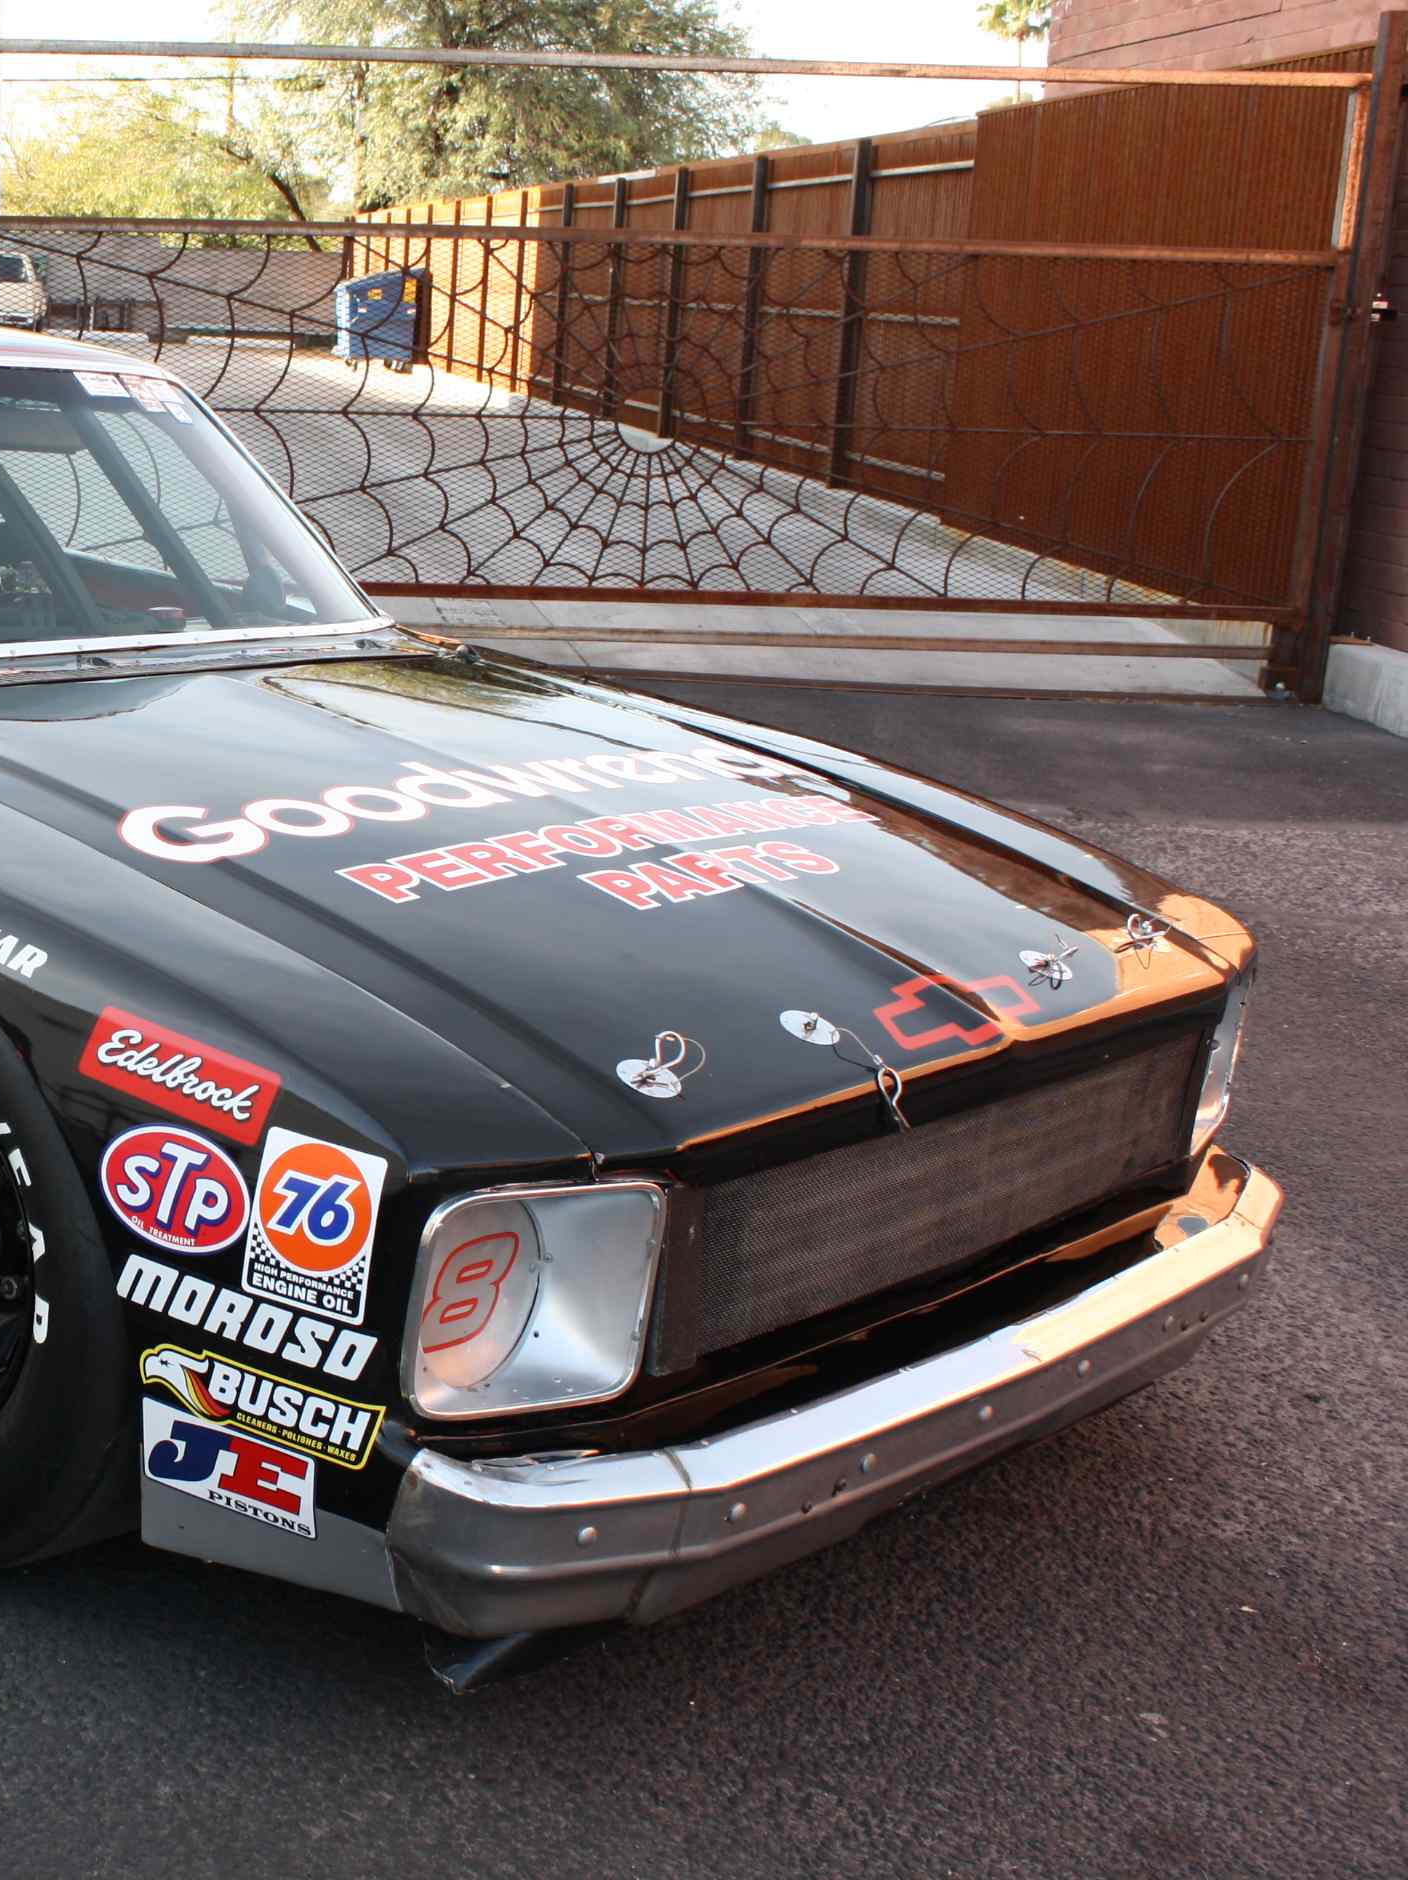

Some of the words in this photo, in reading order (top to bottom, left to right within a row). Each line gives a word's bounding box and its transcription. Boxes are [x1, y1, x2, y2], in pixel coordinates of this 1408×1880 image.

[335, 794, 881, 903] PERFORMANCE
[578, 840, 841, 910] PARTS
[96, 1028, 261, 1122] Edelbrock
[115, 1140, 232, 1238] STP
[130, 1214, 146, 1230] OIL
[148, 1226, 197, 1247] TREATMENT
[267, 1169, 362, 1247] 76
[115, 1253, 379, 1382] MOROSO
[251, 1272, 318, 1305] ENGINE
[322, 1294, 353, 1315] OIL
[253, 1261, 279, 1279] HIGH
[279, 1268, 355, 1300] PERFORMANCE
[420, 1231, 521, 1355] 8
[207, 1358, 372, 1452] BUSCH
[235, 1411, 278, 1434] CLEANERS
[282, 1428, 324, 1450] POLISHES
[327, 1444, 358, 1462] WAXES
[147, 1419, 309, 1516] JE
[207, 1488, 313, 1537] PISTONS
